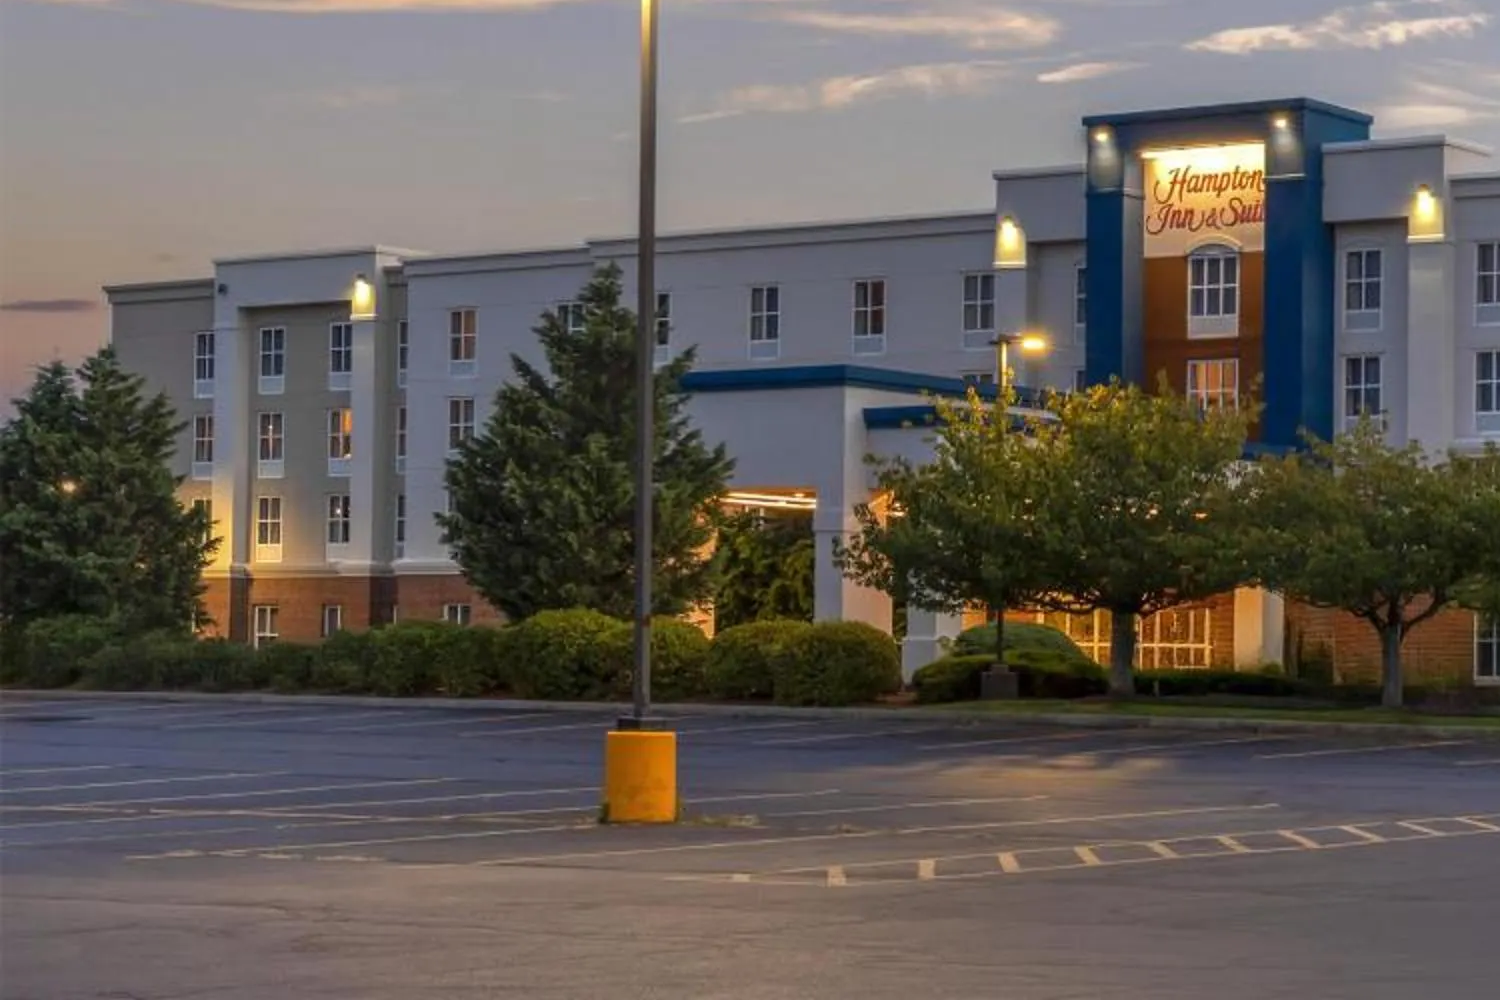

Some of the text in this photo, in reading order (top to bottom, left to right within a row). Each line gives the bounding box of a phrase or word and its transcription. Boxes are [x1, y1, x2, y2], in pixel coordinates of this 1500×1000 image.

[1154, 165, 1264, 204] Hampton
[1146, 203, 1205, 234] Inn
[1206, 207, 1220, 229] &
